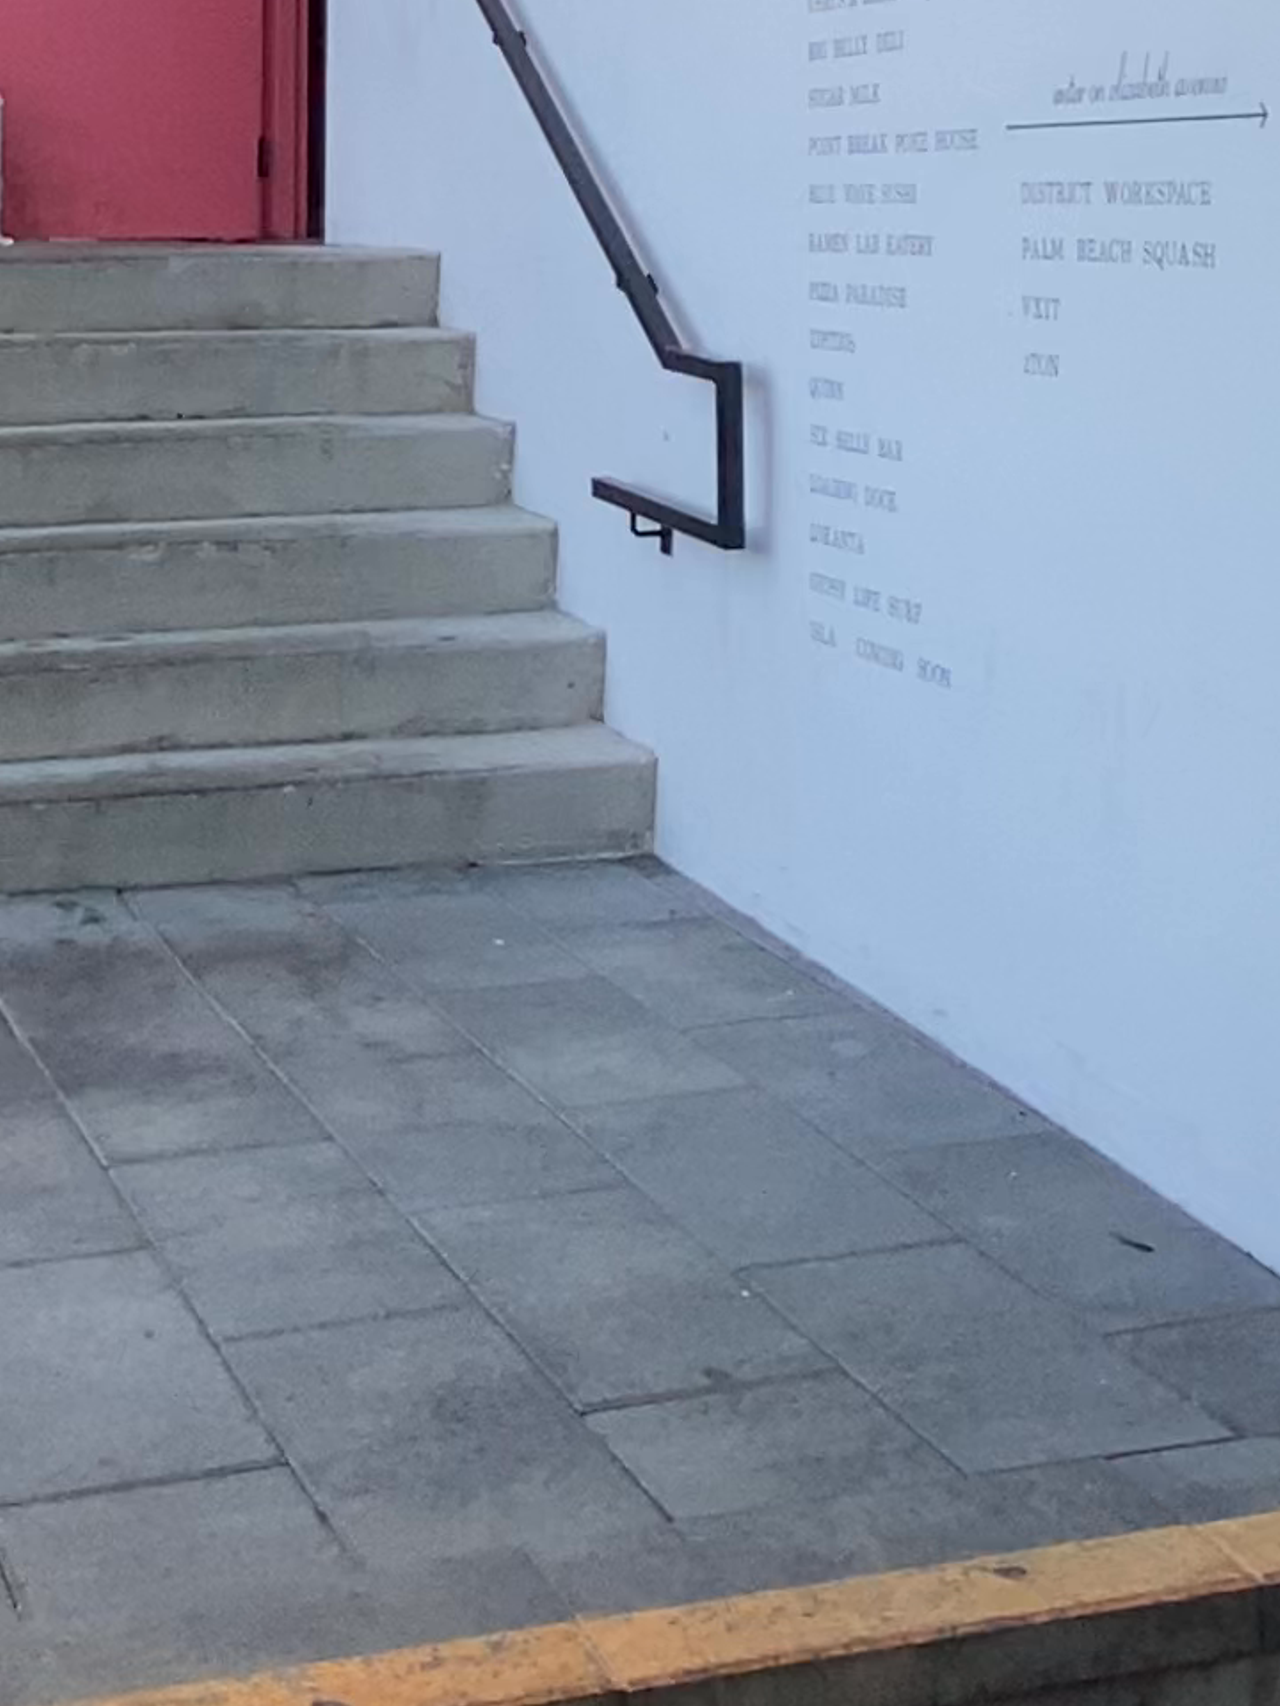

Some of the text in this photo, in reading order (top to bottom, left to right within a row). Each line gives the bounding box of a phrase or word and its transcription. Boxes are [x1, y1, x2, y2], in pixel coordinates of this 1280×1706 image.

[1021, 180, 1213, 206] DISTRICT WORKSPACE
[1021, 236, 1217, 271] PALM BEACH SQUASH
